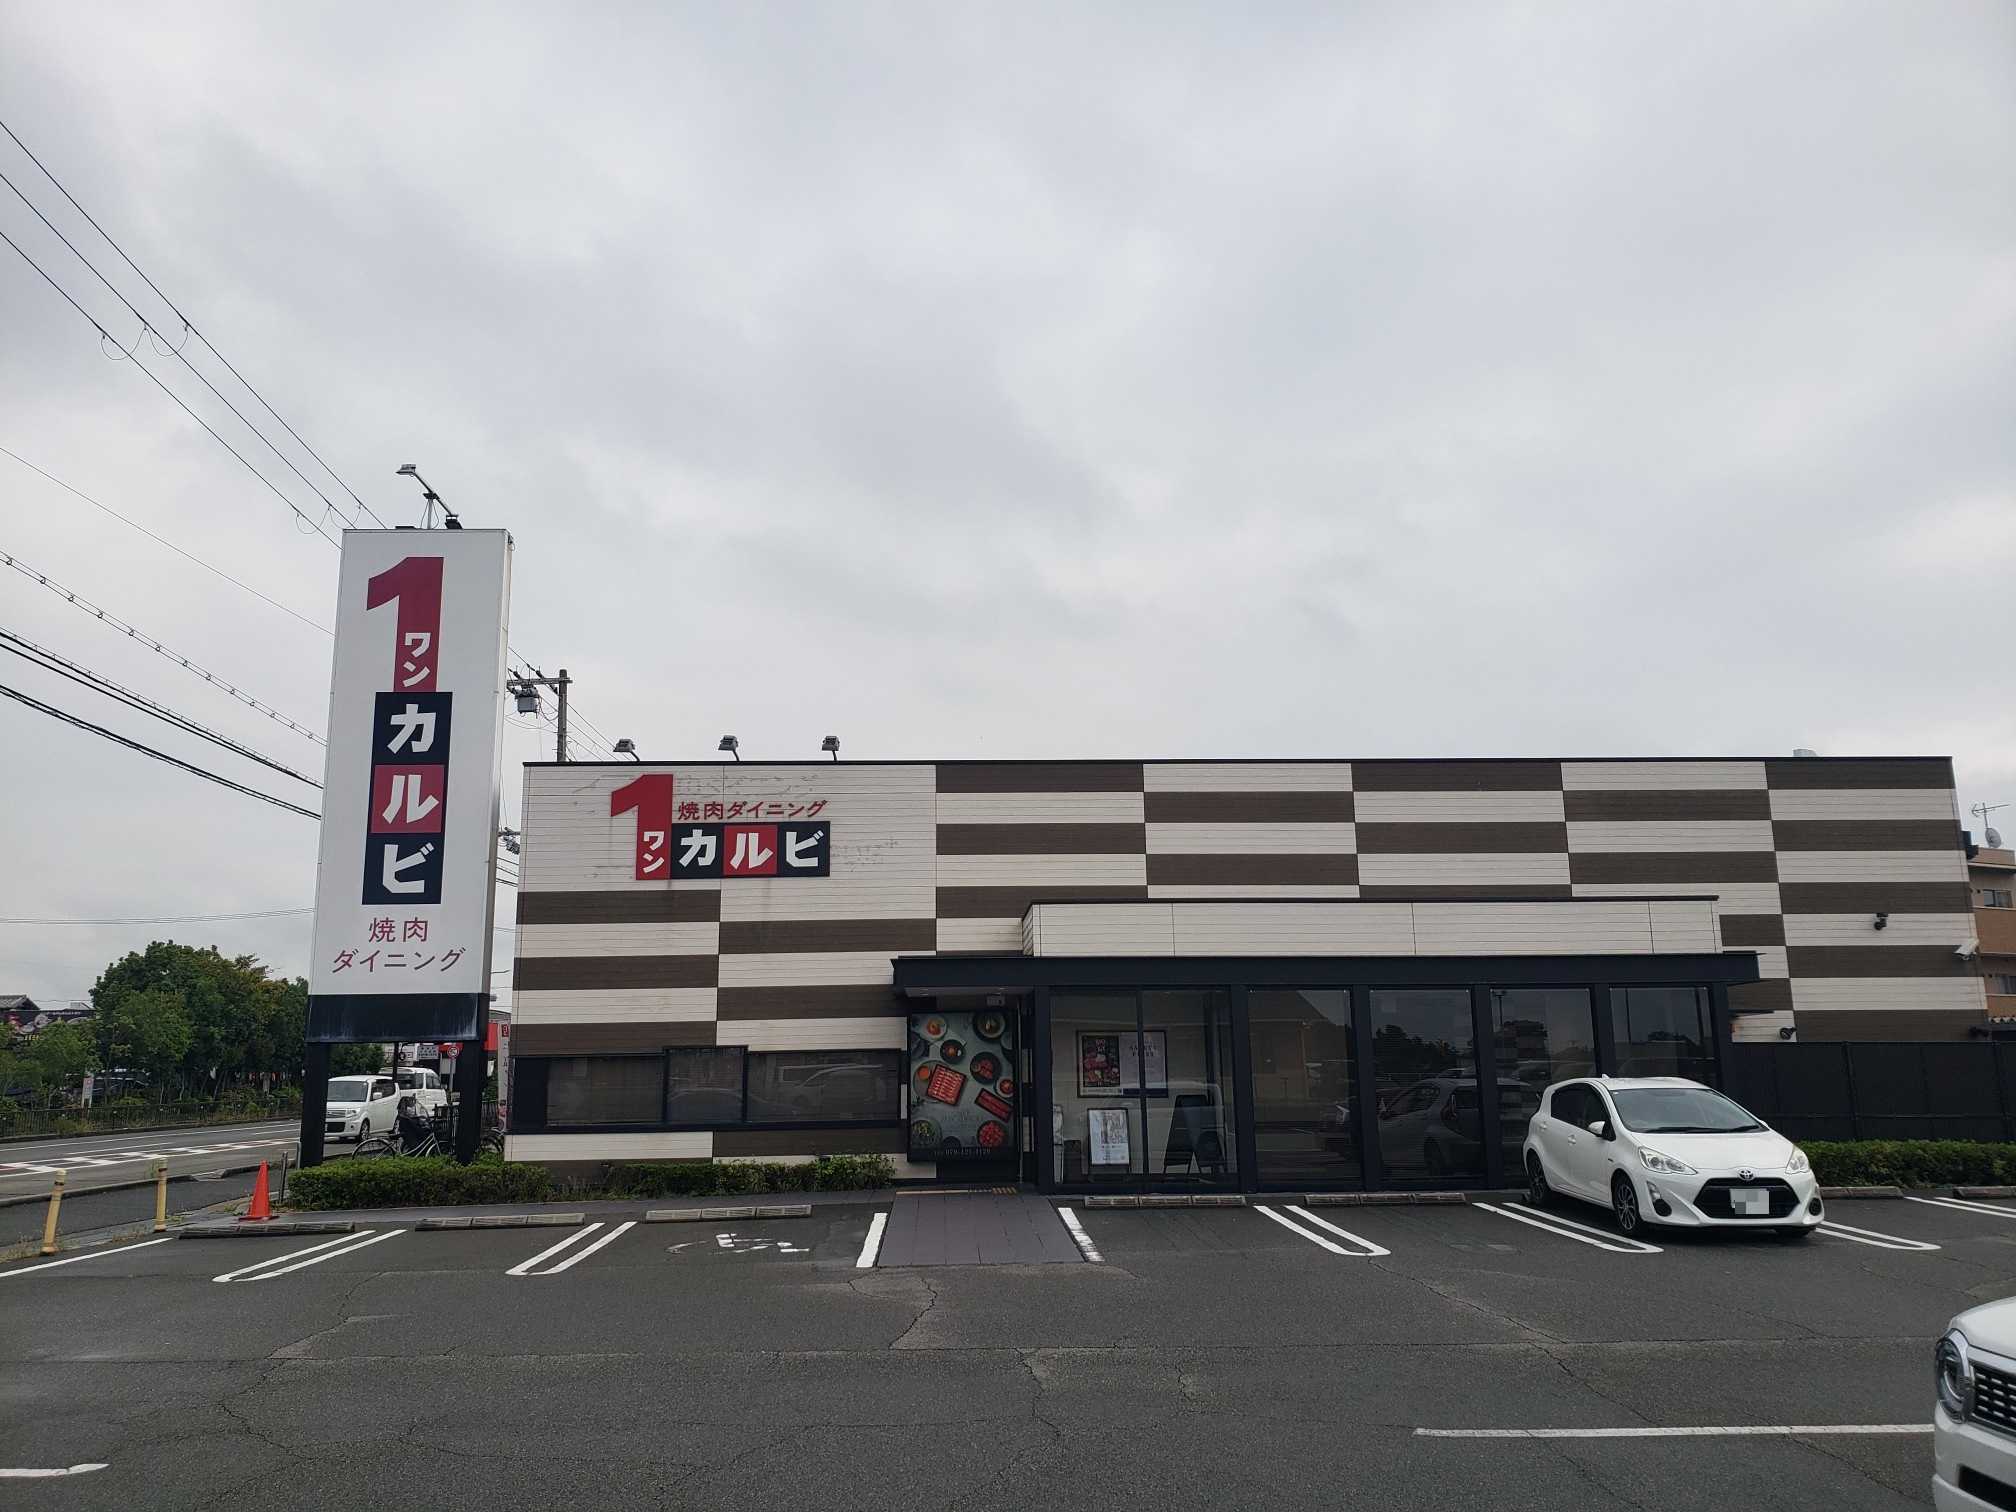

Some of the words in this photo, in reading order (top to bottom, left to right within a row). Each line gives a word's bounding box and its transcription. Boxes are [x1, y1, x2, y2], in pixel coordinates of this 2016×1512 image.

[367, 556, 444, 692] 1
[402, 632, 431, 688] ワン
[382, 703, 440, 894] カルビ
[678, 799, 828, 820] 焼肉ダイニング
[611, 774, 673, 880] 1
[679, 828, 825, 869] カルビ
[643, 831, 665, 874] ワン
[368, 916, 429, 943] 焼肉
[332, 946, 466, 974] ダイニング
